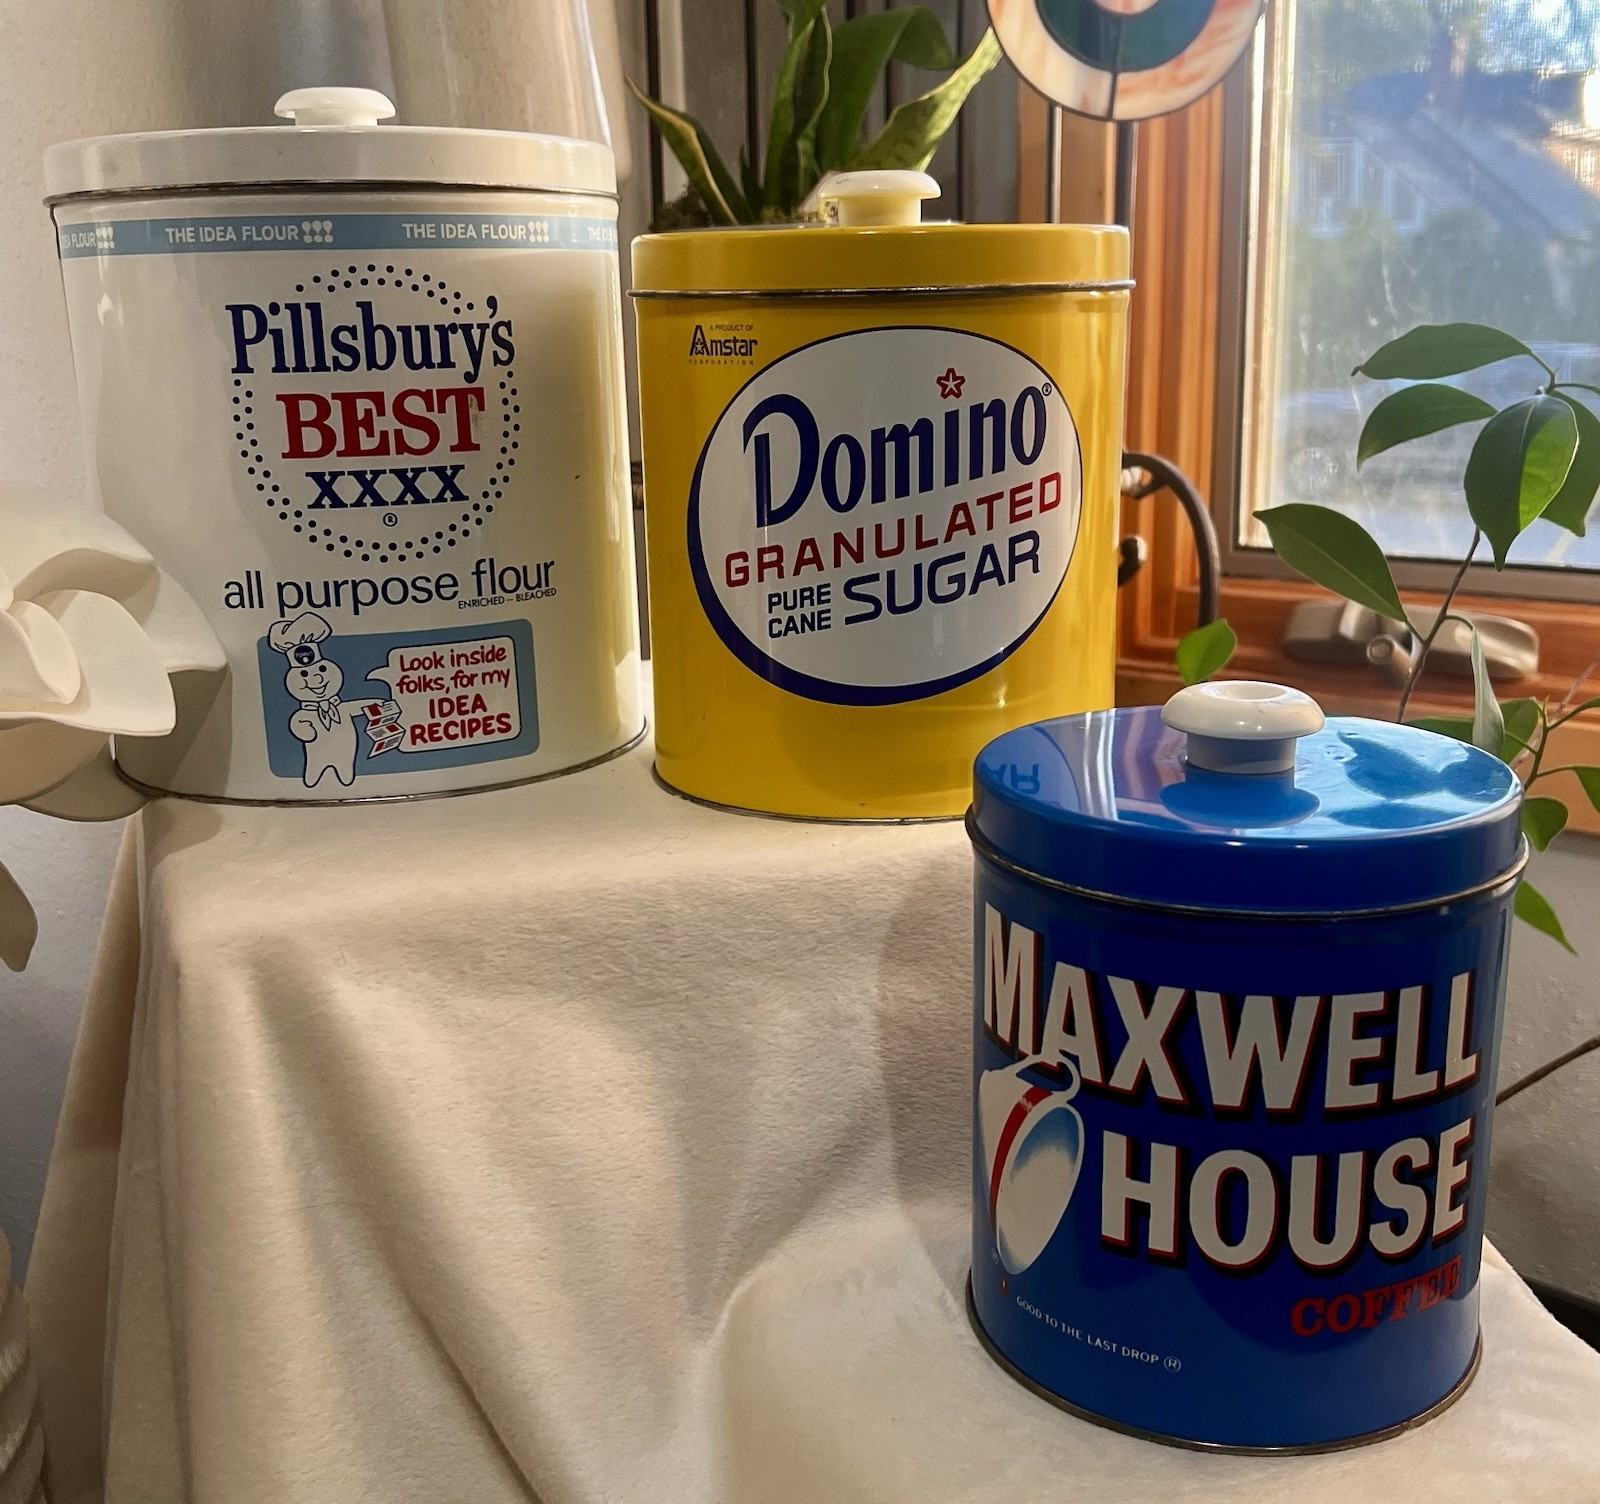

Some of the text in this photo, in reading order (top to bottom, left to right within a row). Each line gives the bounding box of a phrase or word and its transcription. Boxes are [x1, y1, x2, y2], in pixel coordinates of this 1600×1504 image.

[165, 227, 195, 244] THE
[199, 226, 237, 243] IDEA
[402, 223, 437, 239] THE
[440, 223, 477, 239] IDEA
[225, 295, 515, 383] Pillsbury's
[689, 324, 758, 356] Amstar
[688, 358, 754, 366] CORPORATION
[275, 386, 486, 459] BEST
[305, 464, 470, 510] XXXX
[724, 471, 1062, 588] GRANULATED
[224, 557, 556, 618] all purpose flour
[767, 530, 1041, 625] PURE SUGAR
[458, 587, 557, 609] ENRICHED BLEACHED
[767, 608, 832, 639] CANE
[400, 645, 507, 672] Look inside
[396, 668, 510, 694] folks, for my
[428, 693, 488, 719] IDEA
[410, 712, 512, 746] RECIPES
[982, 901, 1481, 1121] MAXWELL
[1100, 1116, 1475, 1272] HOUSE
[1290, 1253, 1462, 1337] COFFEE
[1016, 1295, 1043, 1320] GOOD
[1044, 1313, 1059, 1329] TO
[1061, 1322, 1083, 1340] THE
[1087, 1334, 1118, 1353] LAST
[1121, 1345, 1160, 1365] DROP
